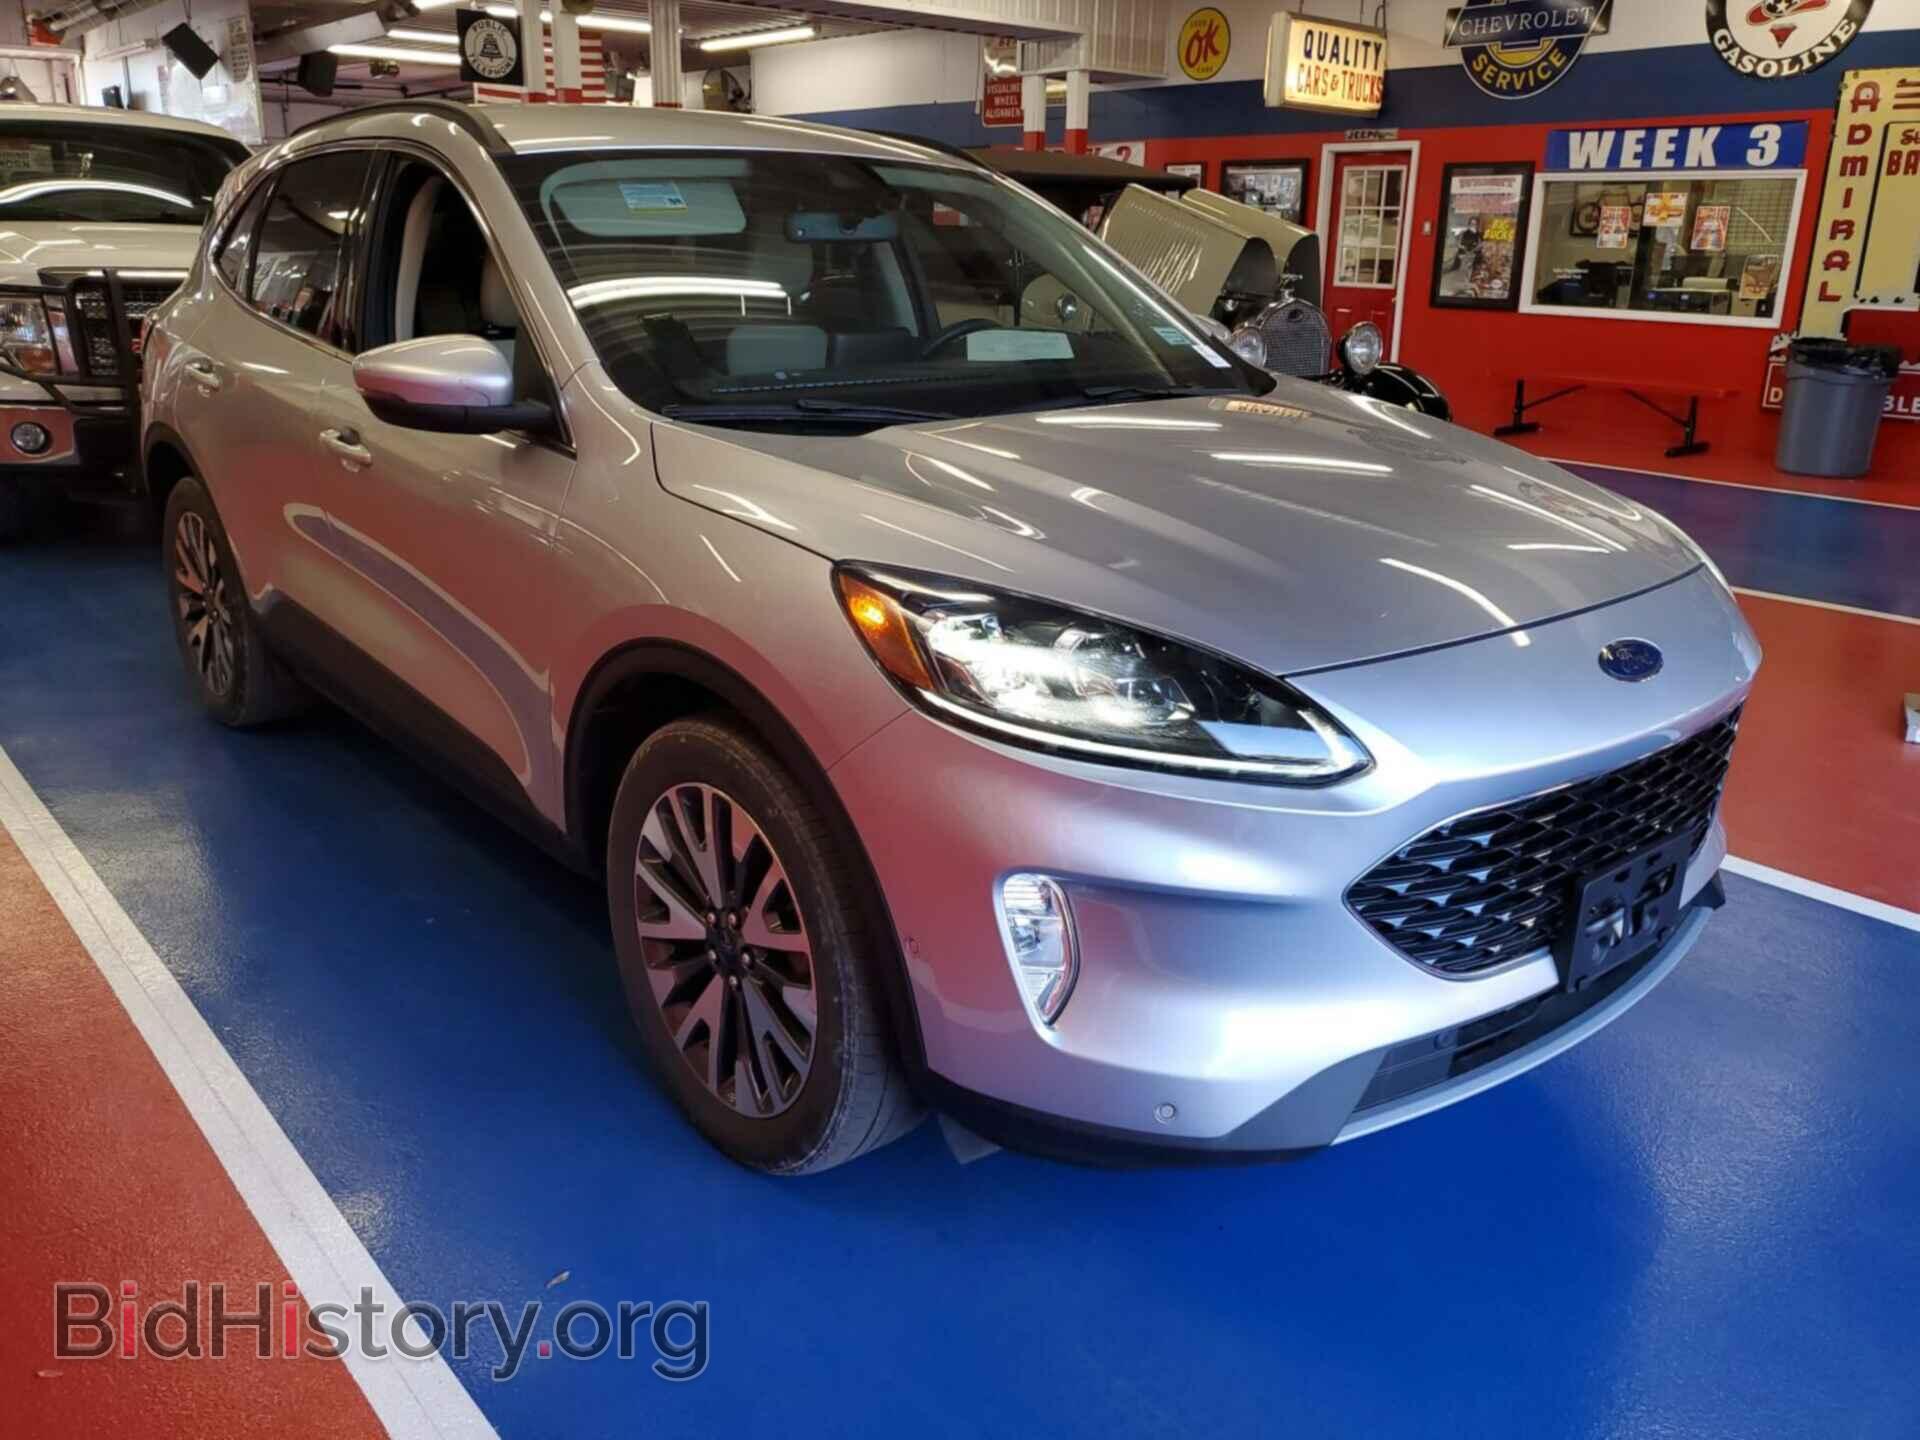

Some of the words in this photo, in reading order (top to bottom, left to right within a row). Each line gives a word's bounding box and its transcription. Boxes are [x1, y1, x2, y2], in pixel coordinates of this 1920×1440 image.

[1459, 7, 1594, 36] CHEVROLET
[1185, 19, 1220, 68] OK
[1304, 29, 1382, 71] QUALITY
[1713, 18, 1856, 78] GASOLINE
[1297, 63, 1329, 96] CARS
[1330, 74, 1339, 91] &
[1341, 70, 1382, 104] TRUCKS
[1472, 48, 1567, 91] SERVICE
[985, 107, 1021, 119] ALIGNMEN
[1568, 126, 1722, 170] WEEK
[1745, 123, 1782, 167] 3
[1817, 81, 1880, 302] ADMIRAL
